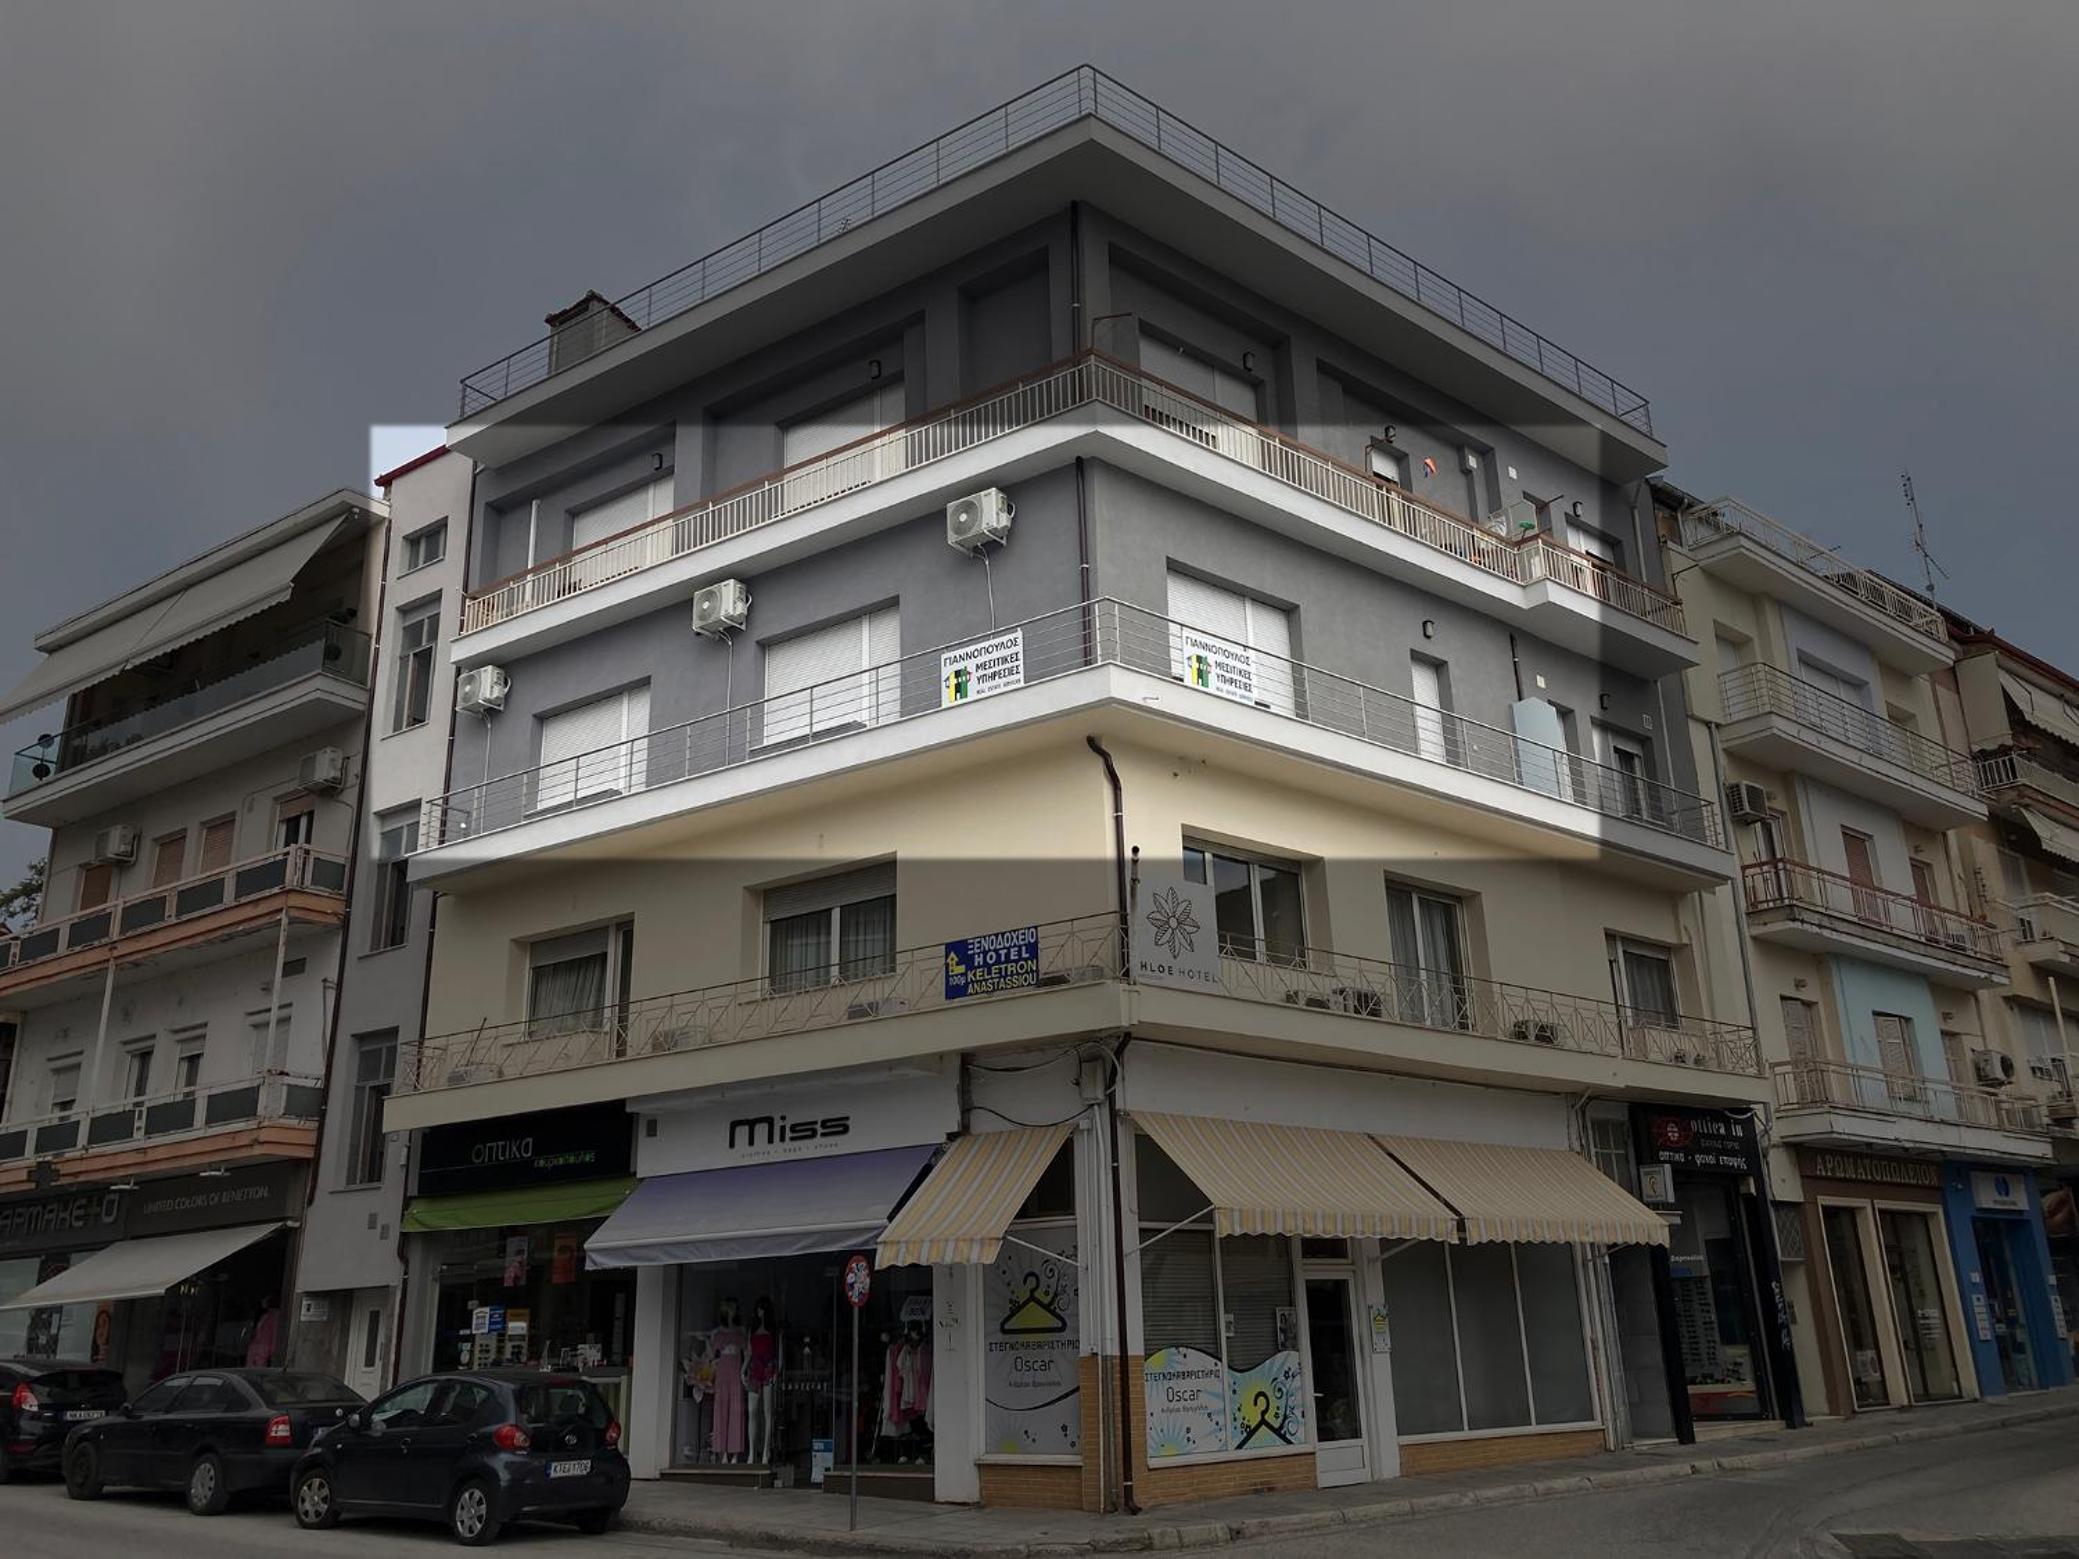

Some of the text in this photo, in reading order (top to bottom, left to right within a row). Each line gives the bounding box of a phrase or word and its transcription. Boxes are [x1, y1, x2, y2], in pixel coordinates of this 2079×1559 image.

[944, 637, 1020, 667] ΓΙΑΝΝΟΠΟΥΛΟΣ
[1185, 635, 1251, 666] ΓΙΑΝΝΟΠΟΥΛΟΣ
[975, 652, 1020, 673] ΜΕΣΙΤΙΚΕΣ
[1215, 660, 1252, 681] ΜΕΣΙΤΙΚΕΣ
[976, 665, 1020, 685] ΥΠΗΡΕΣΙΕΣ
[1216, 673, 1253, 693] ΥΠΗΡΕΣΙΕΣ
[967, 928, 1036, 955] ΞΕΝΟΔΟΧΕΙΟ
[974, 946, 1029, 966] HOTEL
[967, 959, 1037, 982] KELETRON
[1179, 967, 1218, 983] HOTEL
[967, 973, 1037, 995] ANASTASSIOU
[1014, 1356, 1054, 1372] Oscar
[1166, 1386, 1202, 1403] Oscar
